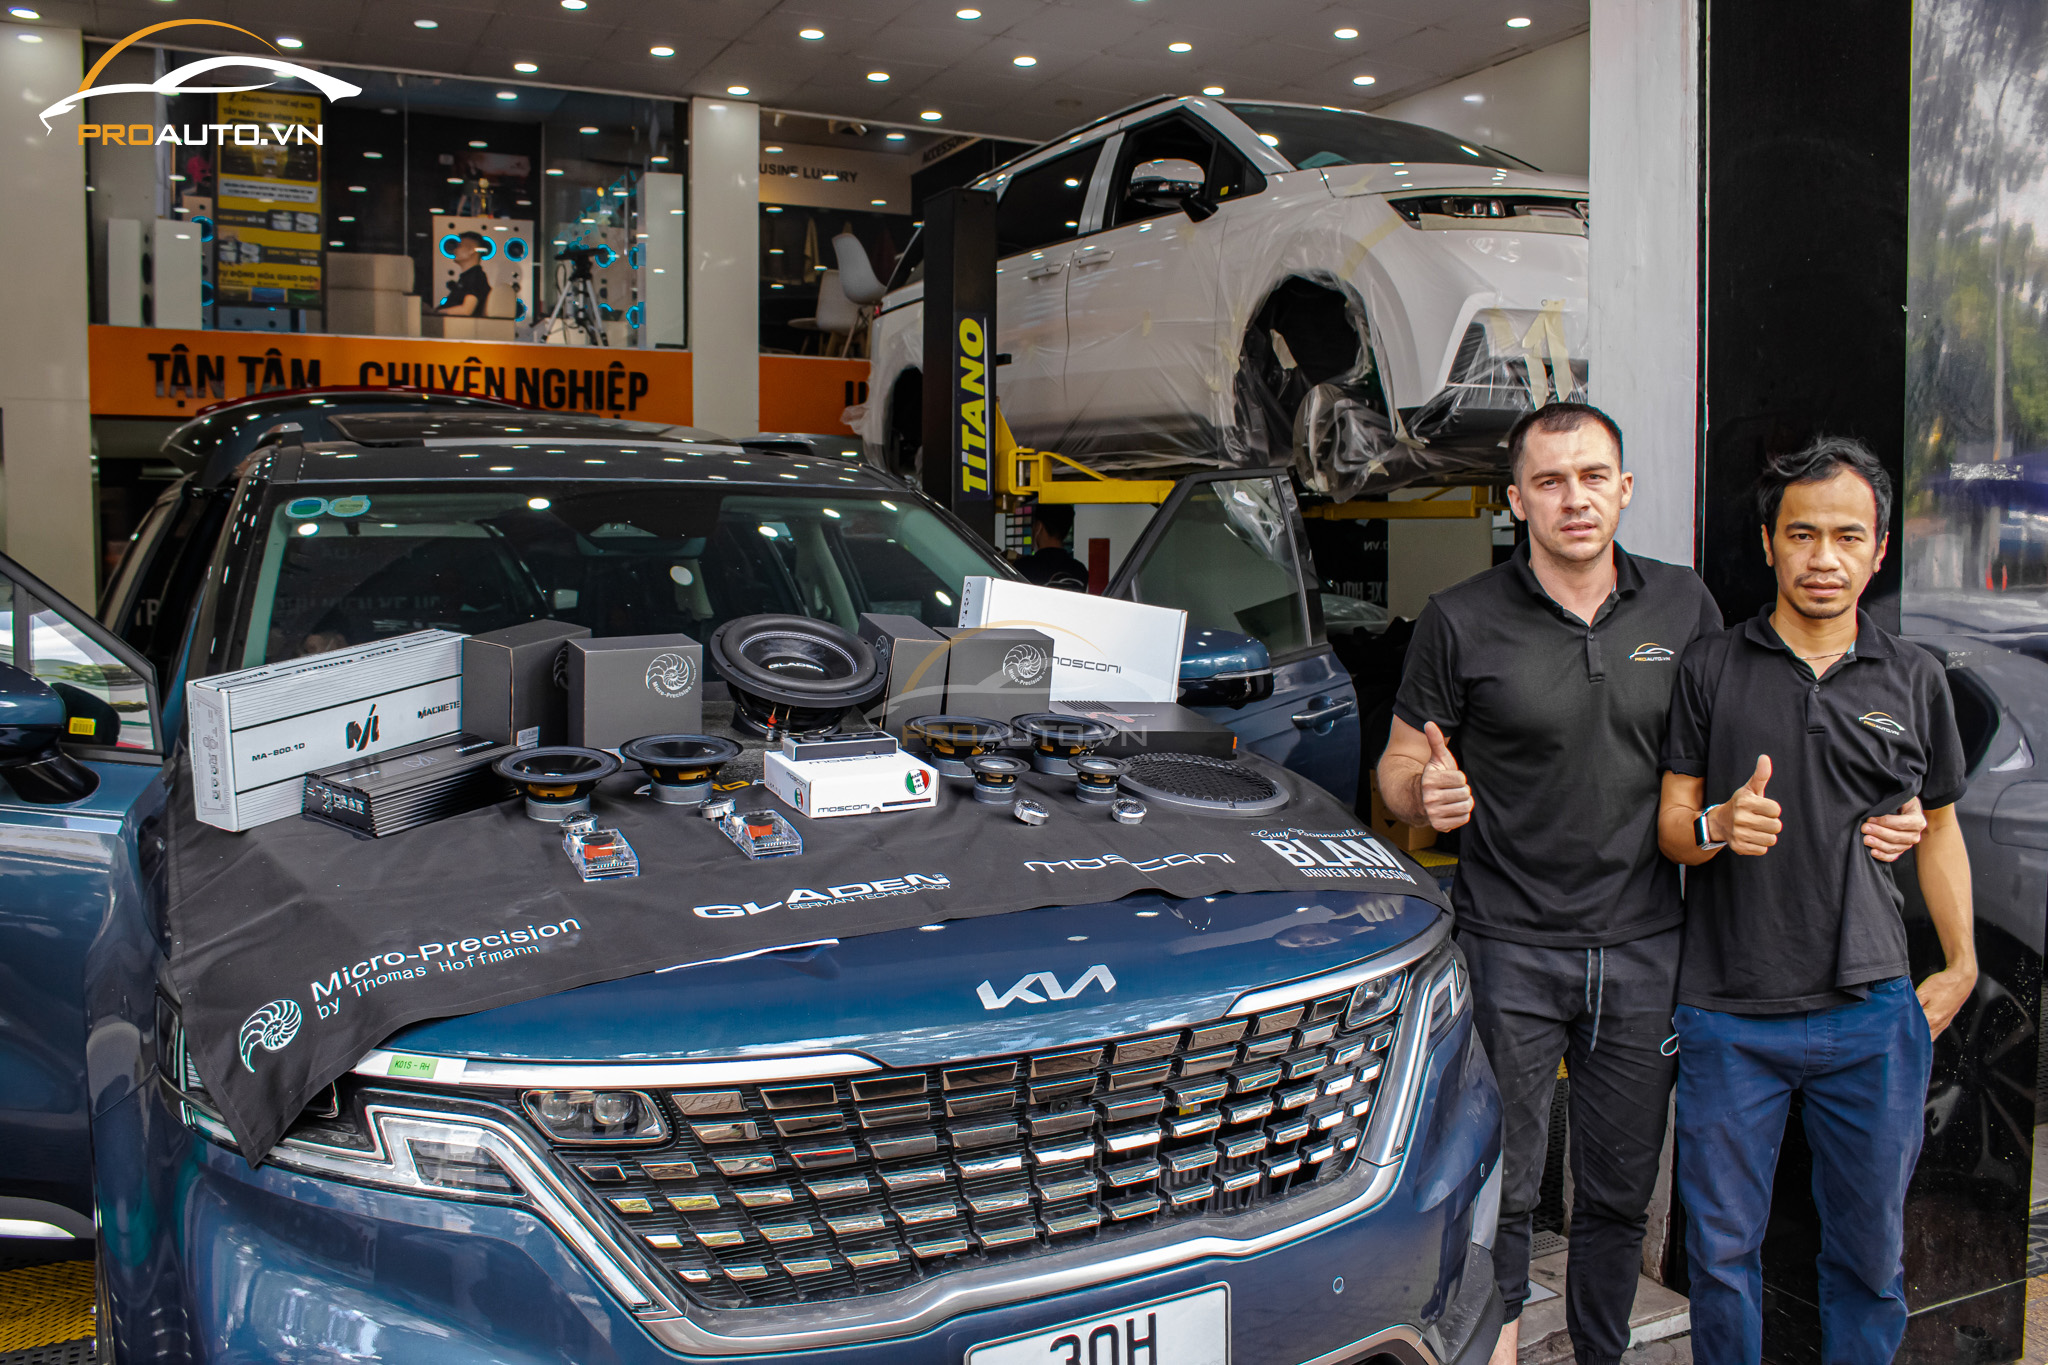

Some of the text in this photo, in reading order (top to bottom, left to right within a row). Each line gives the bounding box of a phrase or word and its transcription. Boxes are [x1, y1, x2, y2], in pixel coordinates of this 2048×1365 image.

[148, 343, 225, 408] TẬN
[516, 361, 649, 419] NGHIỆP
[1260, 836, 1407, 872] BLAM
[1299, 868, 1418, 886] DRIVEN BY PASSION
[787, 882, 951, 911] GERMAN TECHNOLOGY
[310, 917, 582, 1002] Micro-Precision
[316, 944, 541, 1020] by Thomas Hoffmann
[976, 963, 1117, 1010] KIA
[1049, 1311, 1158, 1365] 30H
